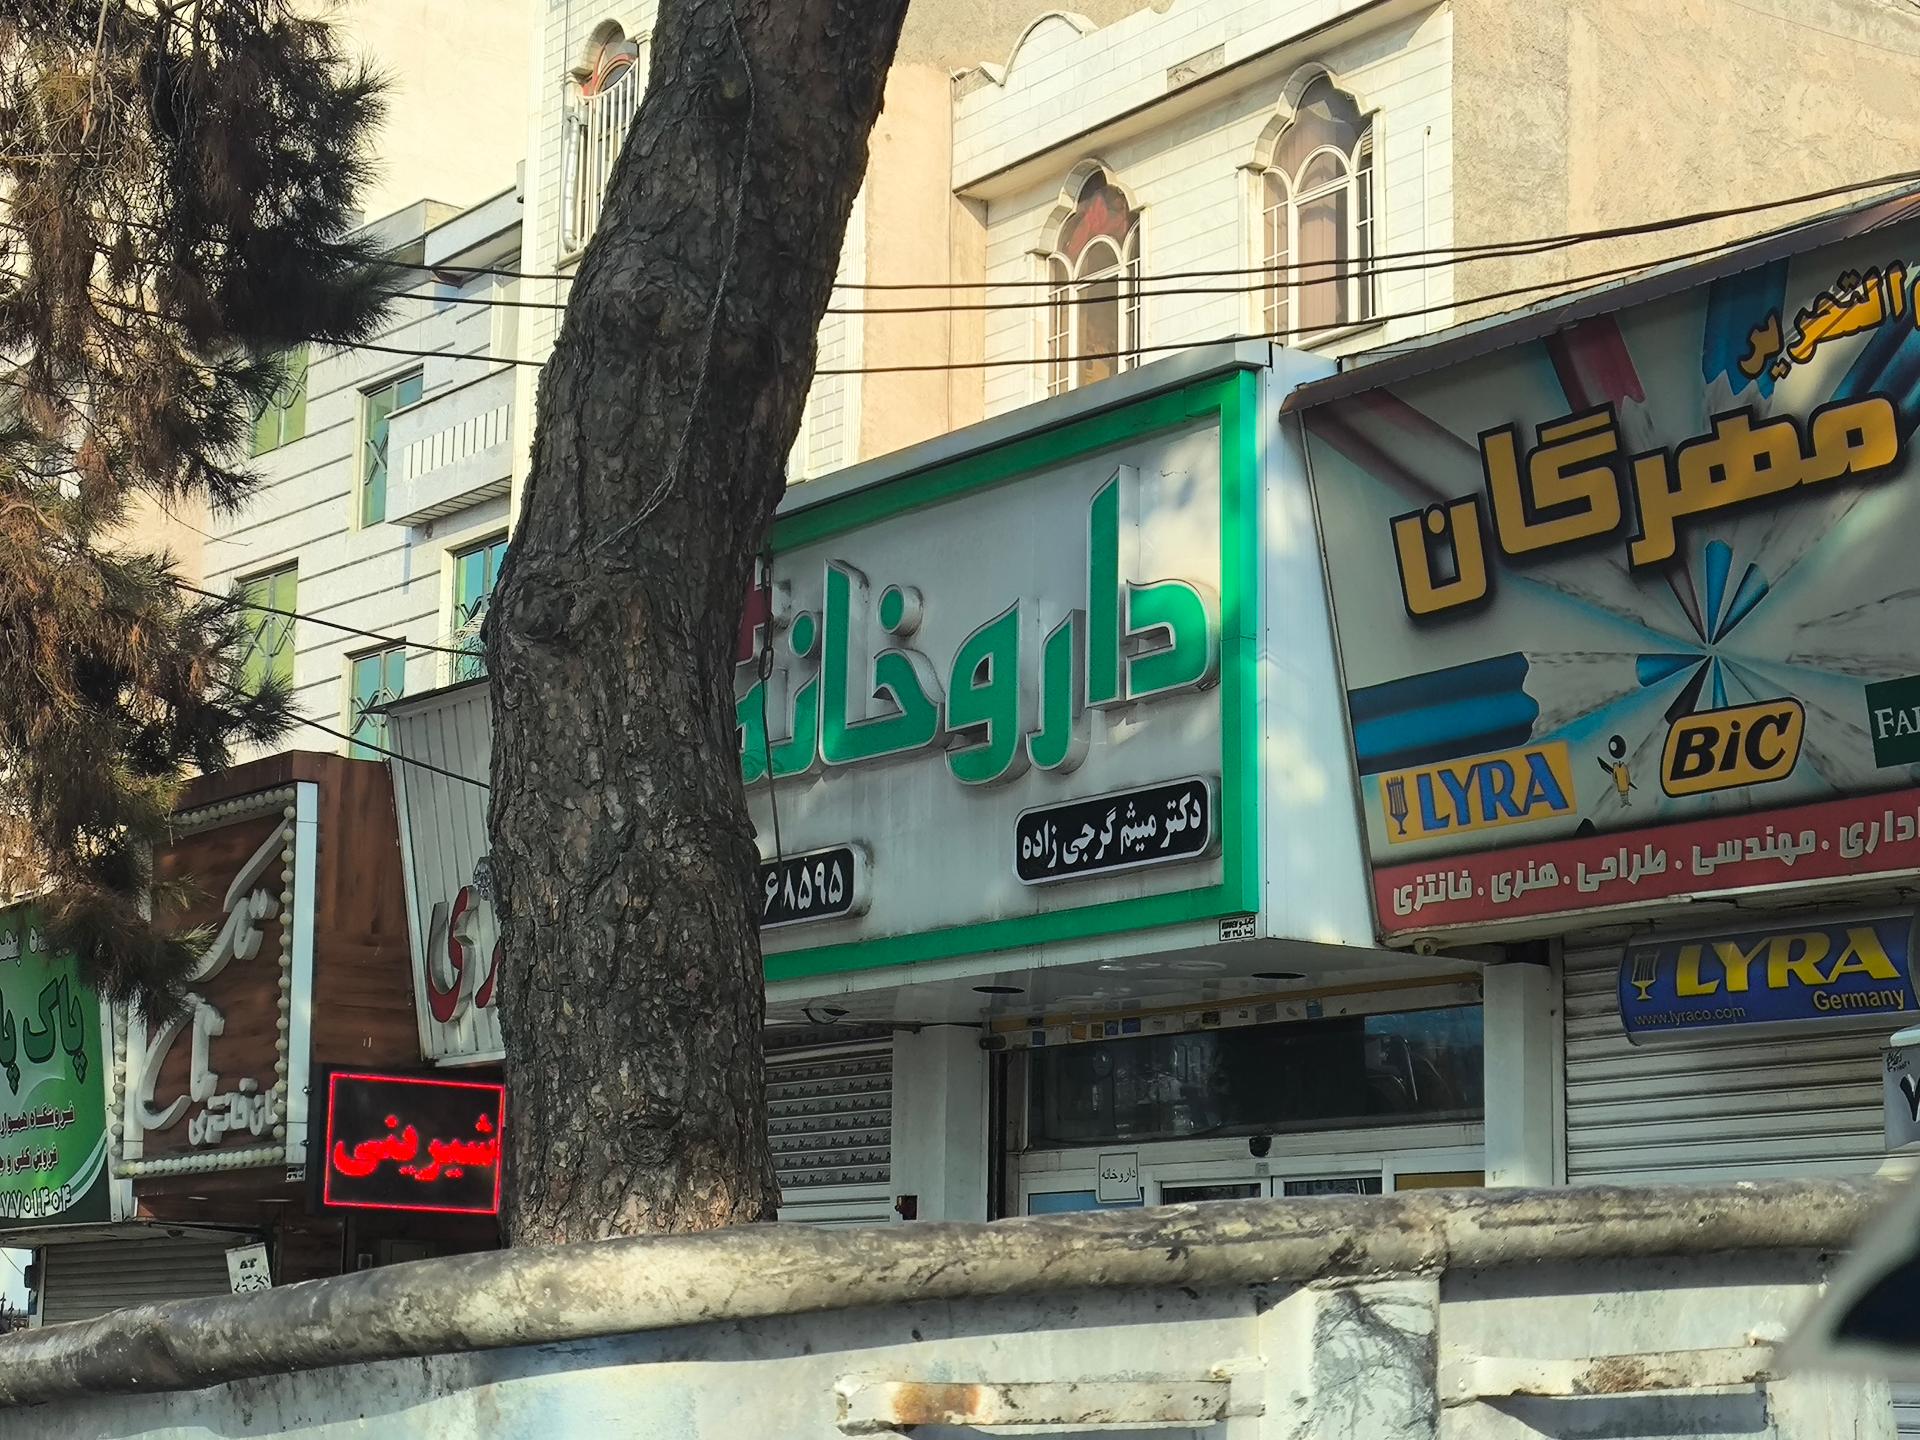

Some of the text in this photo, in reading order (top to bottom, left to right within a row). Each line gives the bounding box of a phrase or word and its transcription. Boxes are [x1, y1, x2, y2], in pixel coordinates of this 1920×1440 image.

[1389, 391, 1900, 619] مهرگان
[1416, 752, 1571, 832] LYRA
[1022, 792, 1201, 869] دکتر میثم گرجی زاده
[1692, 825, 1816, 876] مهندسی
[1393, 870, 1472, 915] فانتزی
[1491, 860, 1559, 903] هنری
[1577, 844, 1667, 893] طراحی
[1676, 926, 1901, 997] LYRA
[1634, 1005, 1746, 1026] www.lyraco.com
[1813, 988, 1905, 1012] Germany
[22, 972, 88, 1086] پاک
[30, 1100, 76, 1130] فروشگاه
[32, 1141, 59, 1172] فروش
[333, 1112, 498, 1183] شیرینی
[1101, 1166, 1136, 1183] داروخانه
